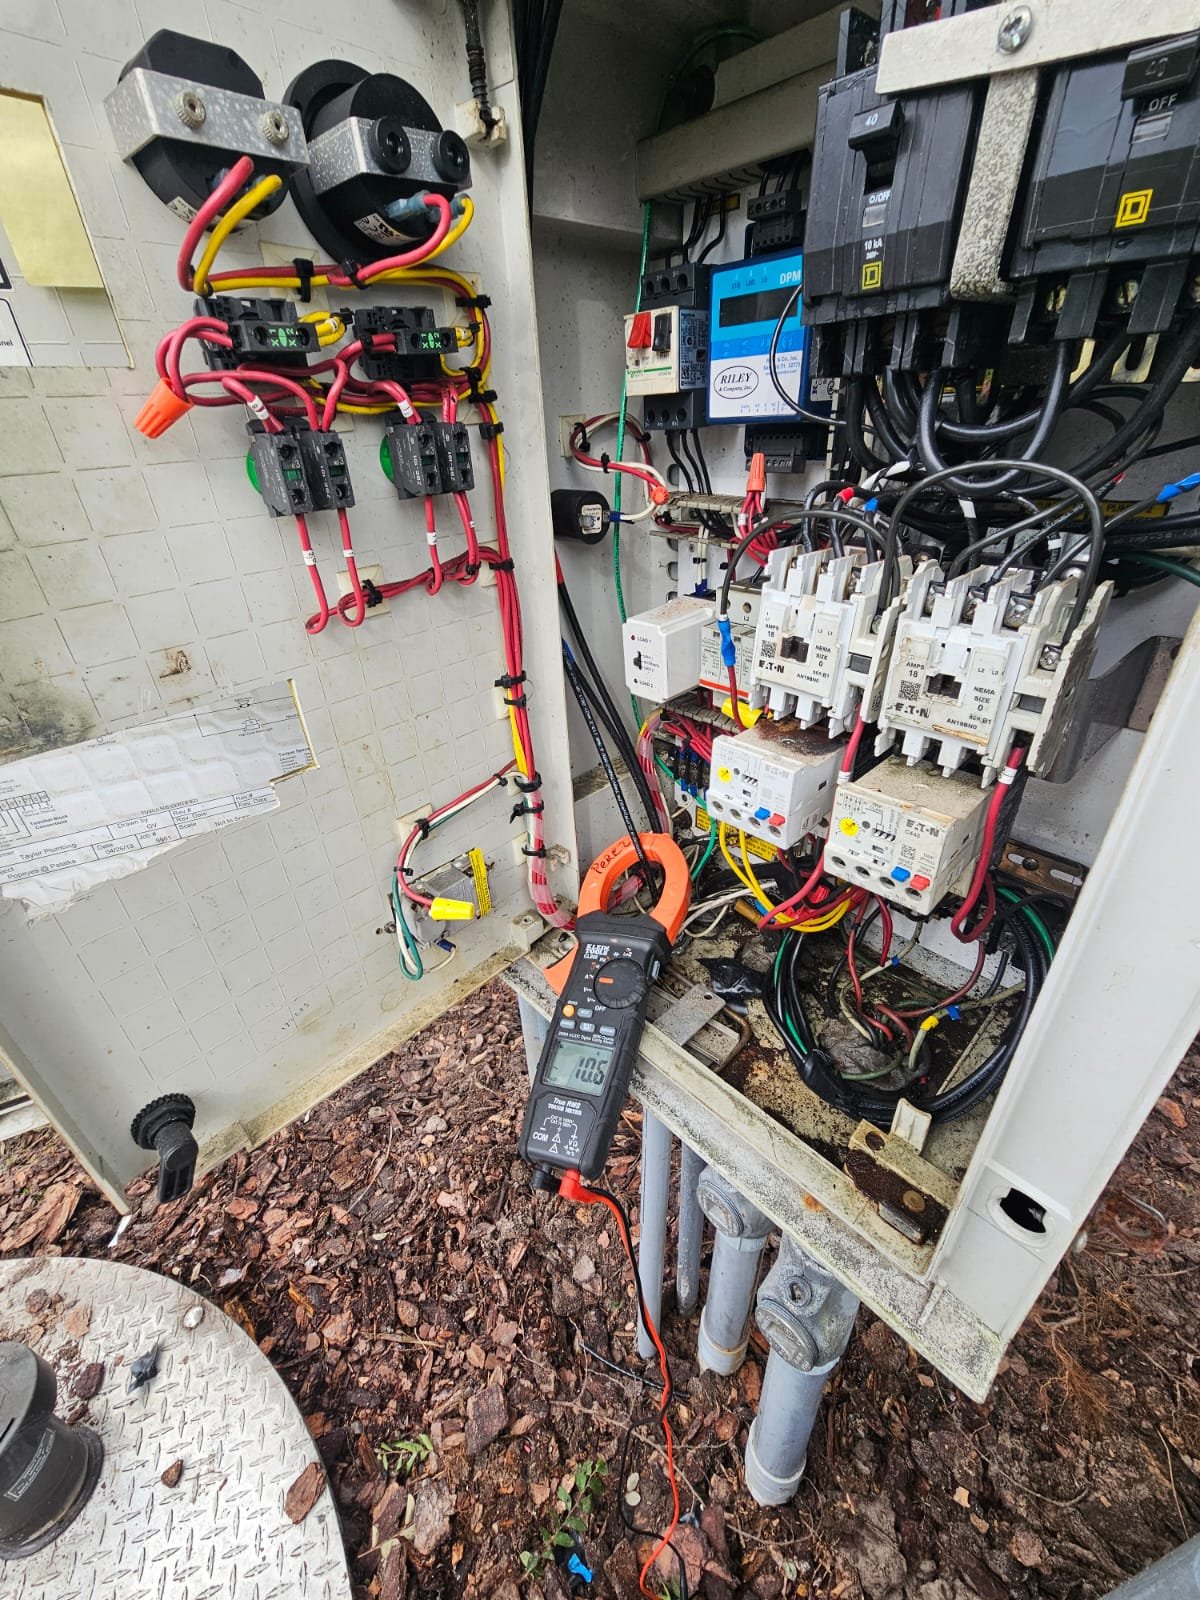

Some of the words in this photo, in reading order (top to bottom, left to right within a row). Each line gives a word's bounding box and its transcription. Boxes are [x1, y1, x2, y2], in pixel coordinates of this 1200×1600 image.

[1148, 93, 1178, 112] OFF
[865, 113, 878, 127] 40
[864, 238, 872, 251] 10
[872, 237, 883, 248] kA
[720, 372, 752, 384] RILEY
[815, 645, 831, 653] NEMA
[816, 653, 828, 661] SIZE
[759, 660, 785, 674] EATON
[906, 661, 925, 670] AMPS
[909, 670, 918, 678] 18
[974, 686, 995, 695] NEMA
[974, 695, 991, 704] SIZE
[895, 702, 929, 719] EATON
[140, 816, 148, 824] by
[179, 822, 197, 830] Scale
[906, 819, 940, 838] EATON
[138, 832, 151, 841] Job
[97, 842, 114, 851] Date
[20, 850, 42, 861] Taylor
[44, 843, 77, 854] Plumbing
[7, 868, 39, 880] Popeyes
[41, 865, 49, 873] @
[586, 943, 610, 951] KLEIN
[553, 1097, 566, 1106] True
[566, 1100, 581, 1109] RMS
[532, 1131, 549, 1142] COM
